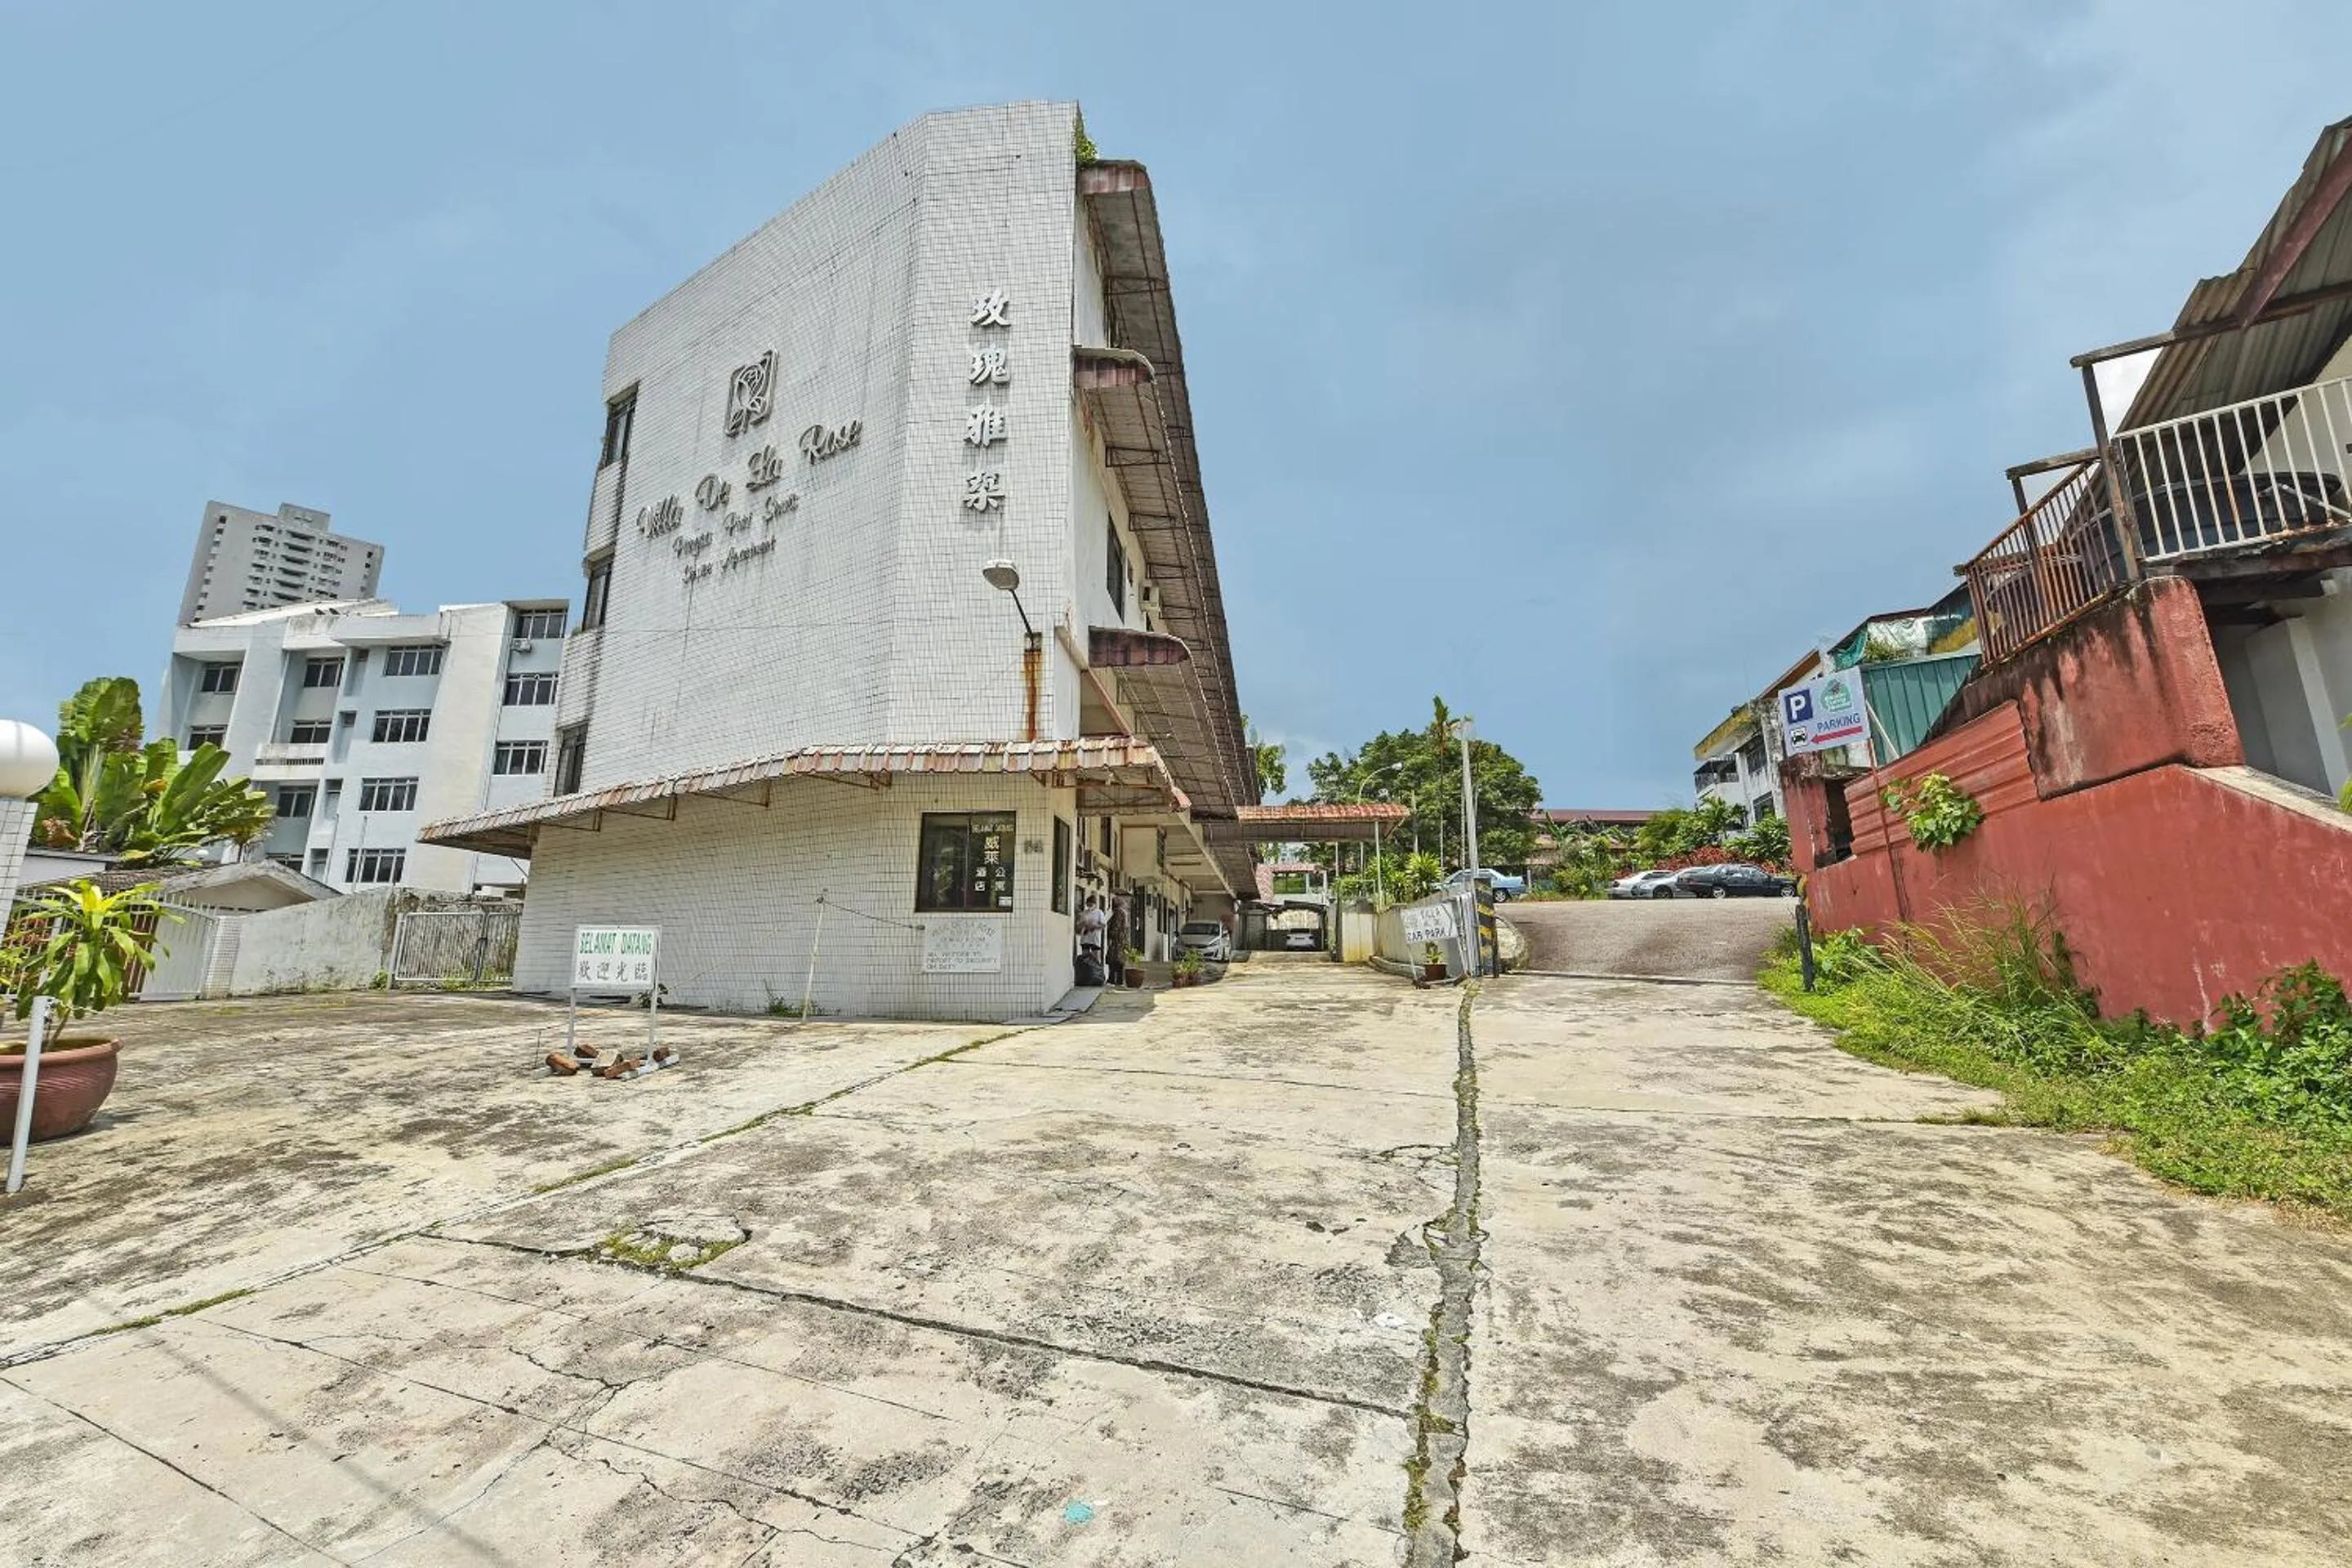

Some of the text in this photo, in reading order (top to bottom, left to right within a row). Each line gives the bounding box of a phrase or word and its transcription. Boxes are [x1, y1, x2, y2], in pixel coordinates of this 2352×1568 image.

[695, 473, 732, 511] De
[745, 444, 783, 492] La
[799, 418, 863, 466] Rose
[1789, 694, 1806, 720] P
[1816, 712, 1860, 732] PARKING
[580, 932, 652, 955] SELAMAT DATANG
